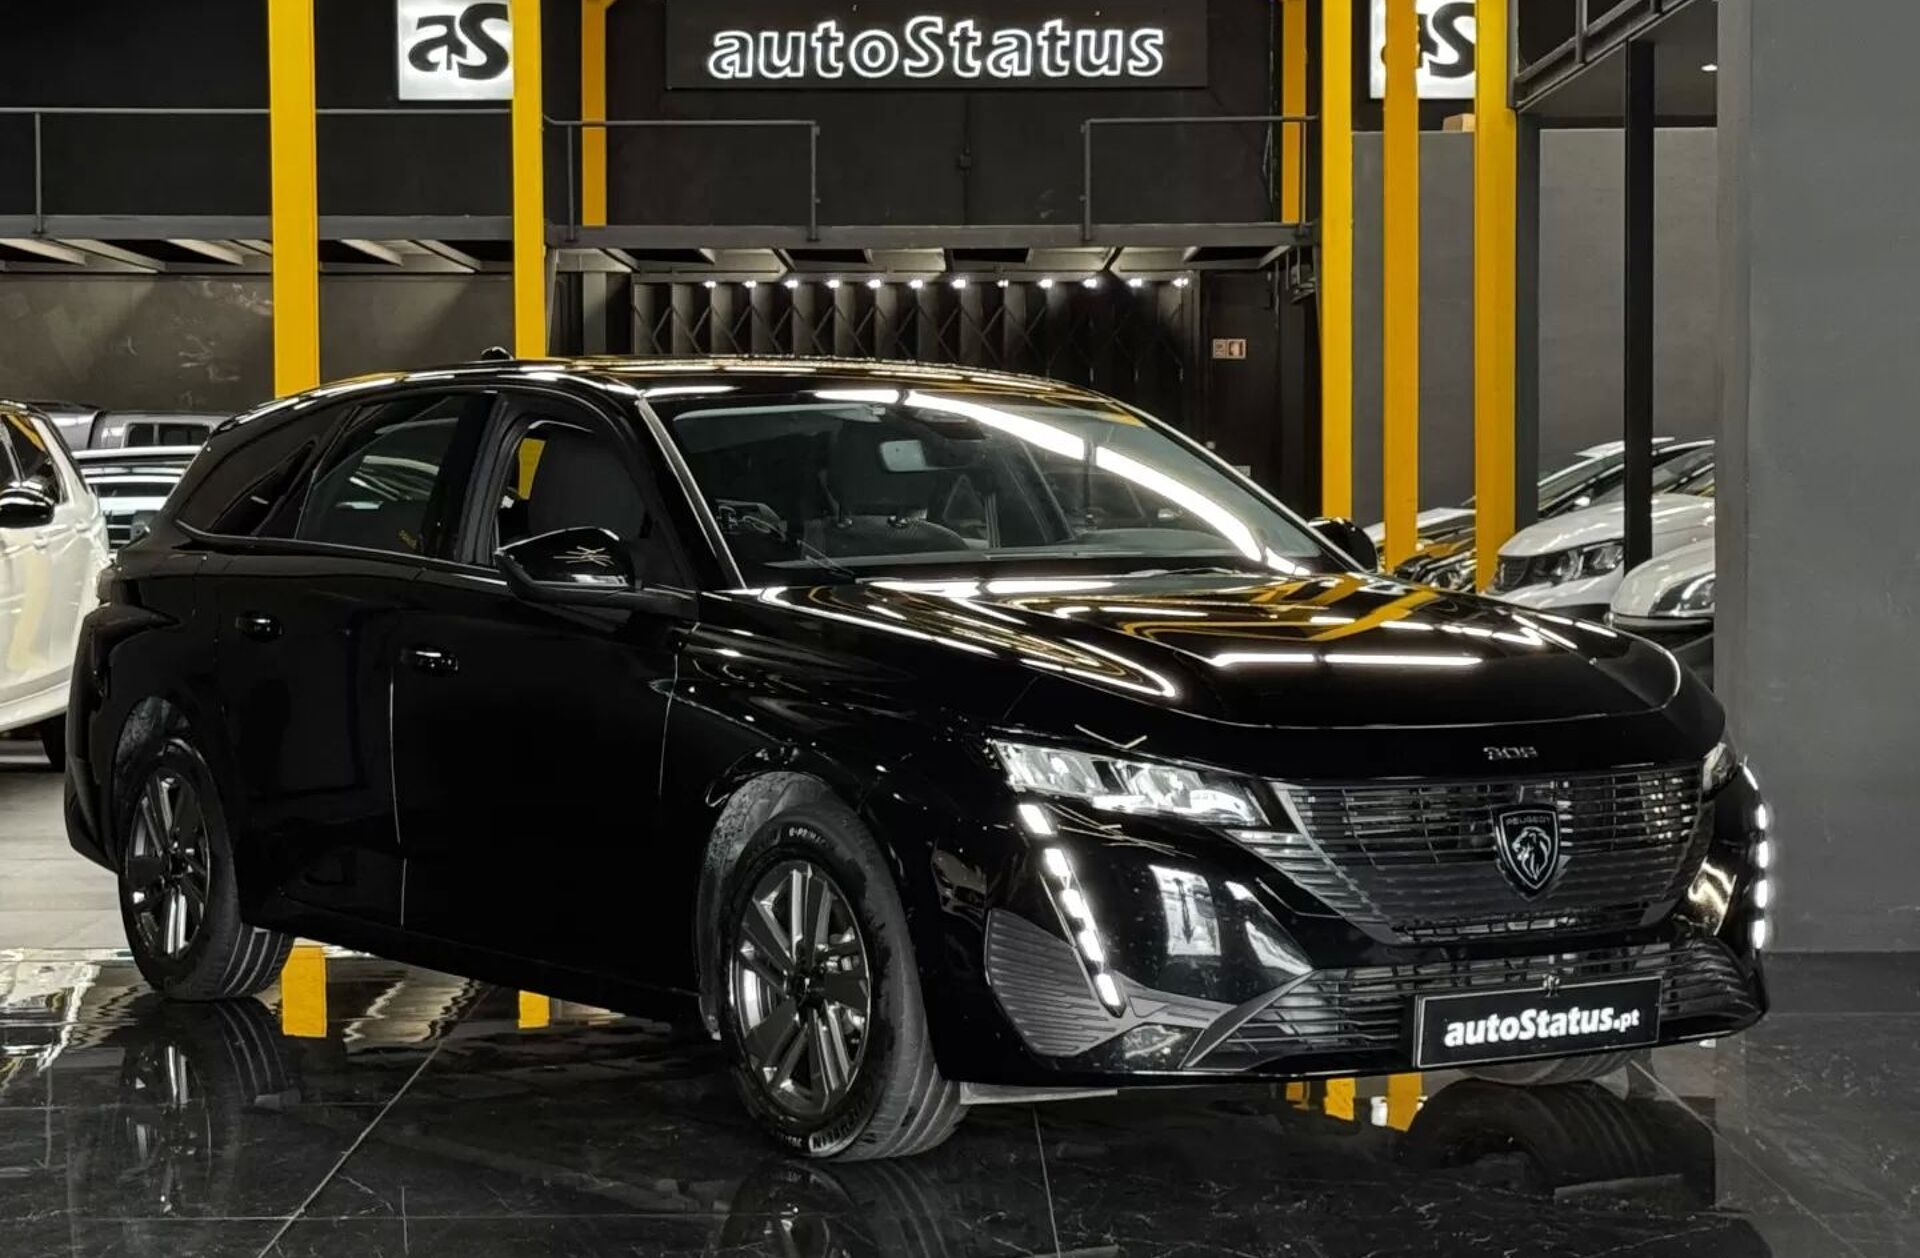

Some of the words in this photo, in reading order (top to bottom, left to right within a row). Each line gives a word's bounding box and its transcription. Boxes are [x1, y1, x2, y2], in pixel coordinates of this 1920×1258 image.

[408, 2, 509, 80] aS
[707, 16, 1165, 80] autoStatus
[1443, 1006, 1641, 1048] autoStatus.pt
